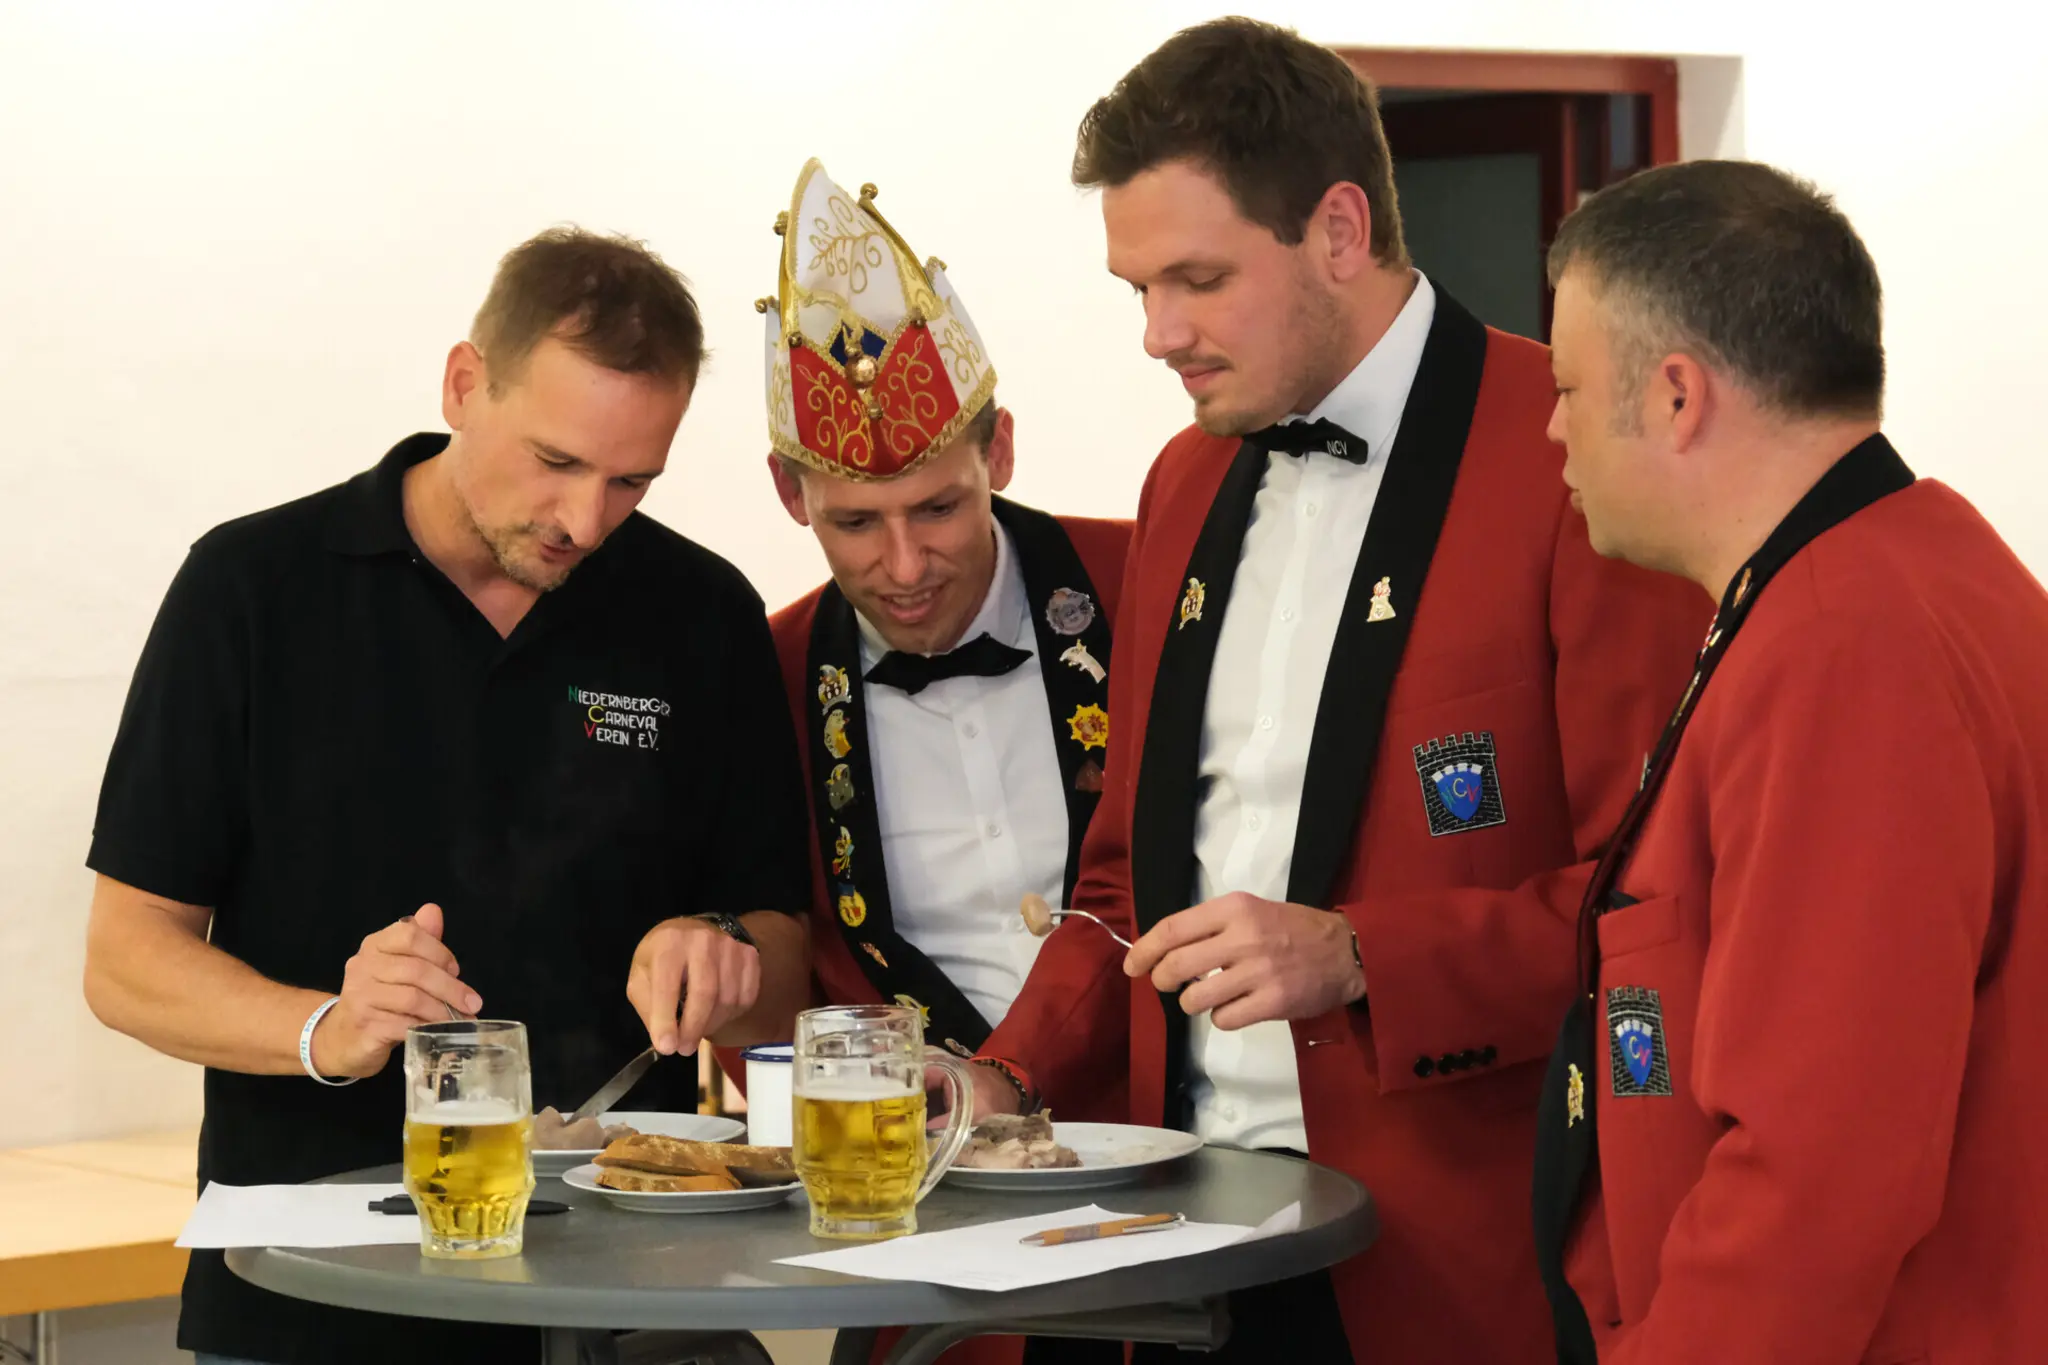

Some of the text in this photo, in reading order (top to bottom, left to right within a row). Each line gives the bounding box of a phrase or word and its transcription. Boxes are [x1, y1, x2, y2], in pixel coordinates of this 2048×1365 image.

[1326, 440, 1348, 456] NCV
[588, 705, 659, 732] CARNEVAL
[584, 720, 630, 746] VEREIN
[1441, 777, 1480, 810] NCV
